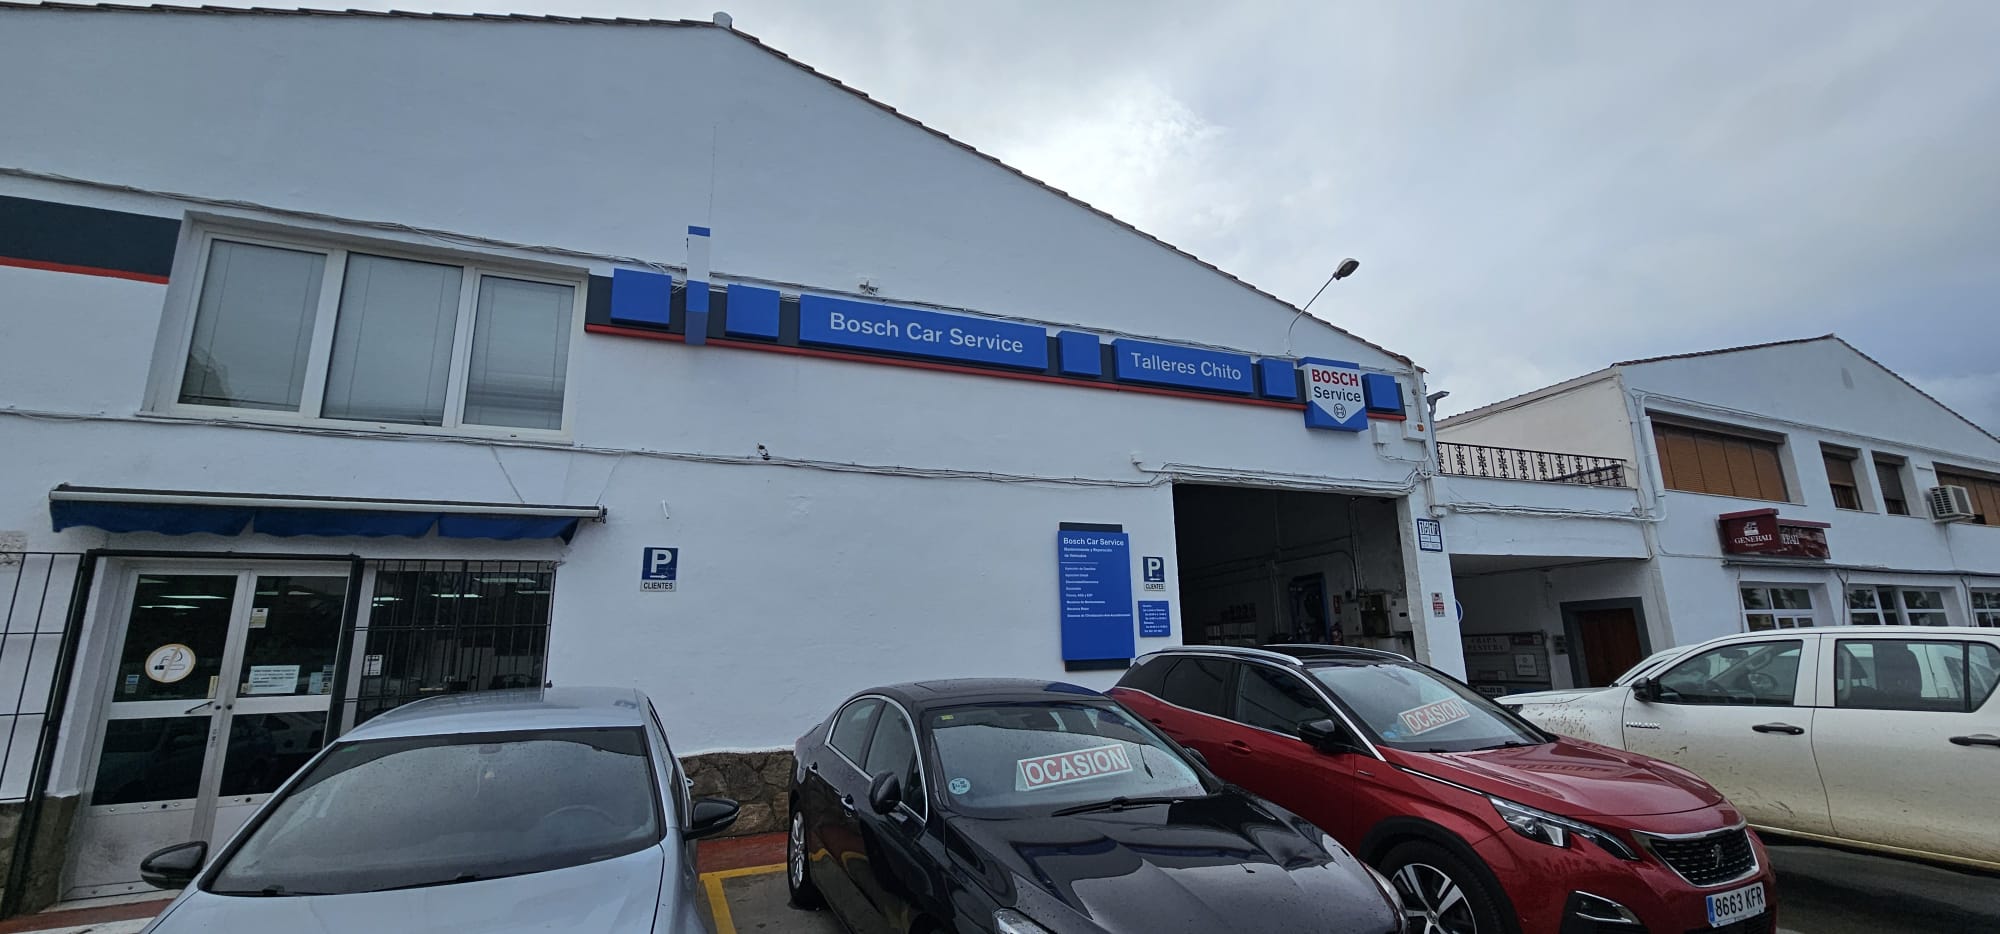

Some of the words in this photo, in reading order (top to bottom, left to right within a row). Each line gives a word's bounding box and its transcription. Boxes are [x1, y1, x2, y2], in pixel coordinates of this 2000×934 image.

[829, 311, 899, 337] Bosch
[906, 322, 942, 343] Car
[949, 328, 1023, 353] Service
[1130, 352, 1196, 375] Talleres
[1200, 361, 1242, 381] Chito
[1311, 368, 1359, 387] BOSCH
[1313, 386, 1361, 403] Service
[1063, 537, 1086, 545] Bosch
[1099, 538, 1124, 546] Service
[1734, 534, 1772, 544] GENERALI
[650, 549, 673, 574] P
[1148, 557, 1161, 577] P
[643, 581, 673, 590] CLIENTES
[1405, 700, 1466, 731] OCASION
[1025, 748, 1128, 785] OCASION
[1715, 893, 1743, 917] 8663
[1744, 886, 1764, 910] KFR
